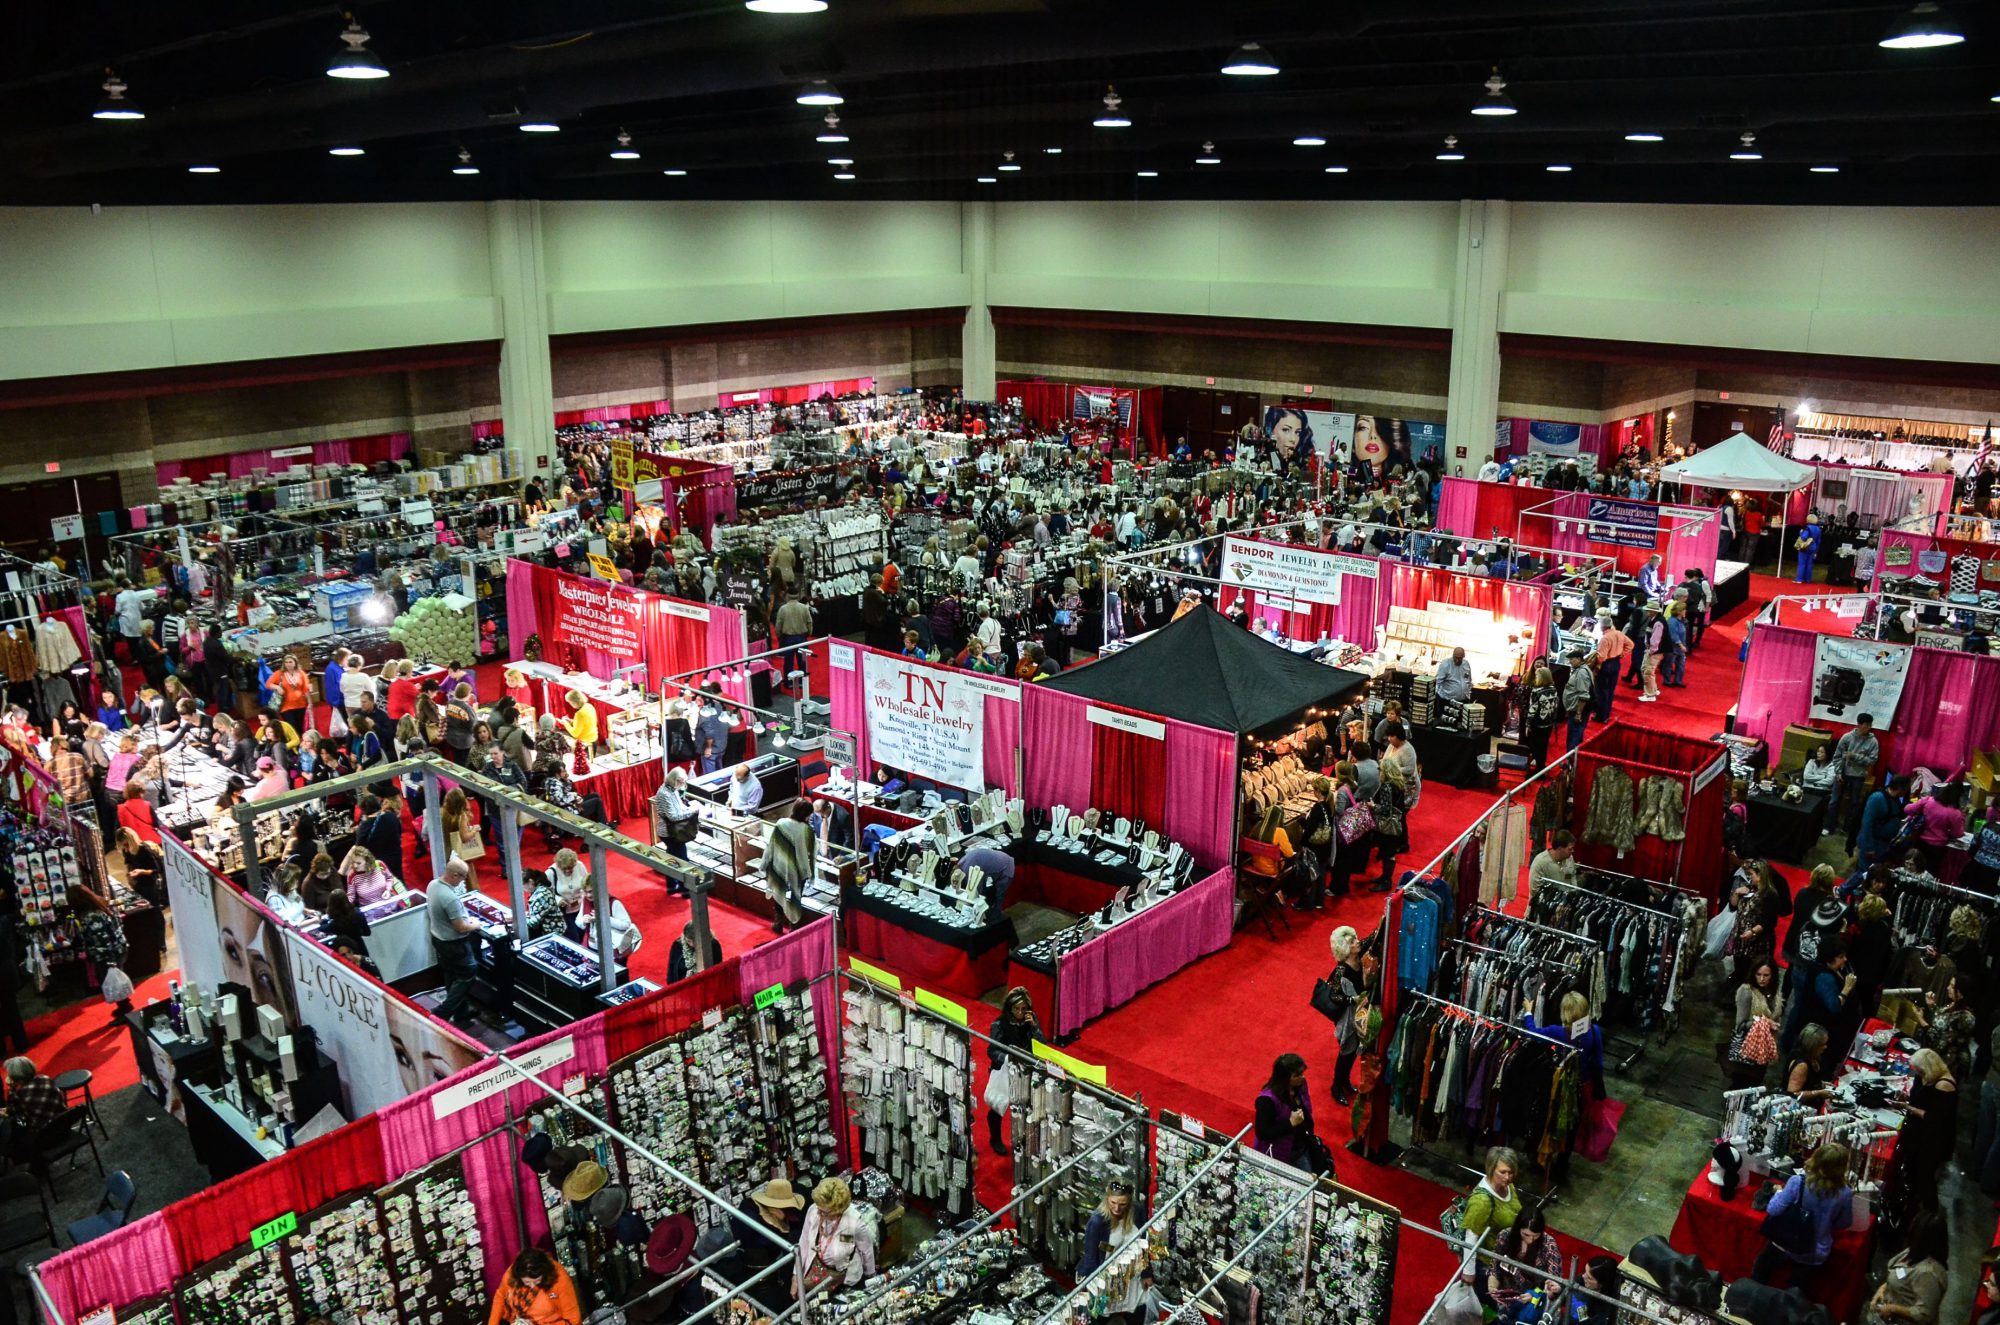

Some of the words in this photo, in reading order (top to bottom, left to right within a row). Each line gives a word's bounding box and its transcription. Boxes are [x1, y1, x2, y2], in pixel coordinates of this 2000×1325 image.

[616, 458, 628, 479] $5
[741, 483, 768, 497] Three
[771, 478, 802, 495] Sisters
[1606, 504, 1657, 519] American
[1617, 531, 1654, 541] SPECIALISTS
[1231, 544, 1274, 561] BENDOR
[1282, 554, 1317, 568] JEWELRY
[597, 564, 613, 573] GOLD
[1351, 559, 1375, 569] DIAMONDS
[1257, 569, 1288, 581] DIAMONDS
[1294, 576, 1328, 587] GEMSTONES
[1360, 568, 1376, 577] PRICES
[727, 577, 747, 589] Estate
[726, 589, 752, 603] Jewelry
[605, 591, 641, 619] Jewelry
[571, 605, 624, 625] WHOLESALE
[836, 648, 849, 658] LOOSE
[898, 671, 947, 712] TN
[969, 681, 989, 690] WHOLESALE
[875, 695, 930, 720] Wholesale
[932, 710, 974, 733] Jewelry
[889, 714, 921, 731] Knoxville,
[1112, 716, 1124, 725] TAHITI
[1124, 720, 1138, 728] BEADS
[878, 722, 906, 735] Diamond
[912, 731, 928, 742] Ring
[933, 737, 947, 748] Semi
[948, 742, 971, 753] Mount
[830, 740, 847, 751] LOOSE
[918, 743, 930, 751] 14k
[825, 748, 852, 763] DIAMONDS
[757, 990, 773, 1005] HAIR
[468, 1078, 494, 1096] PRETTY
[495, 1068, 517, 1084] LITTLE
[260, 1219, 288, 1240] PIN
